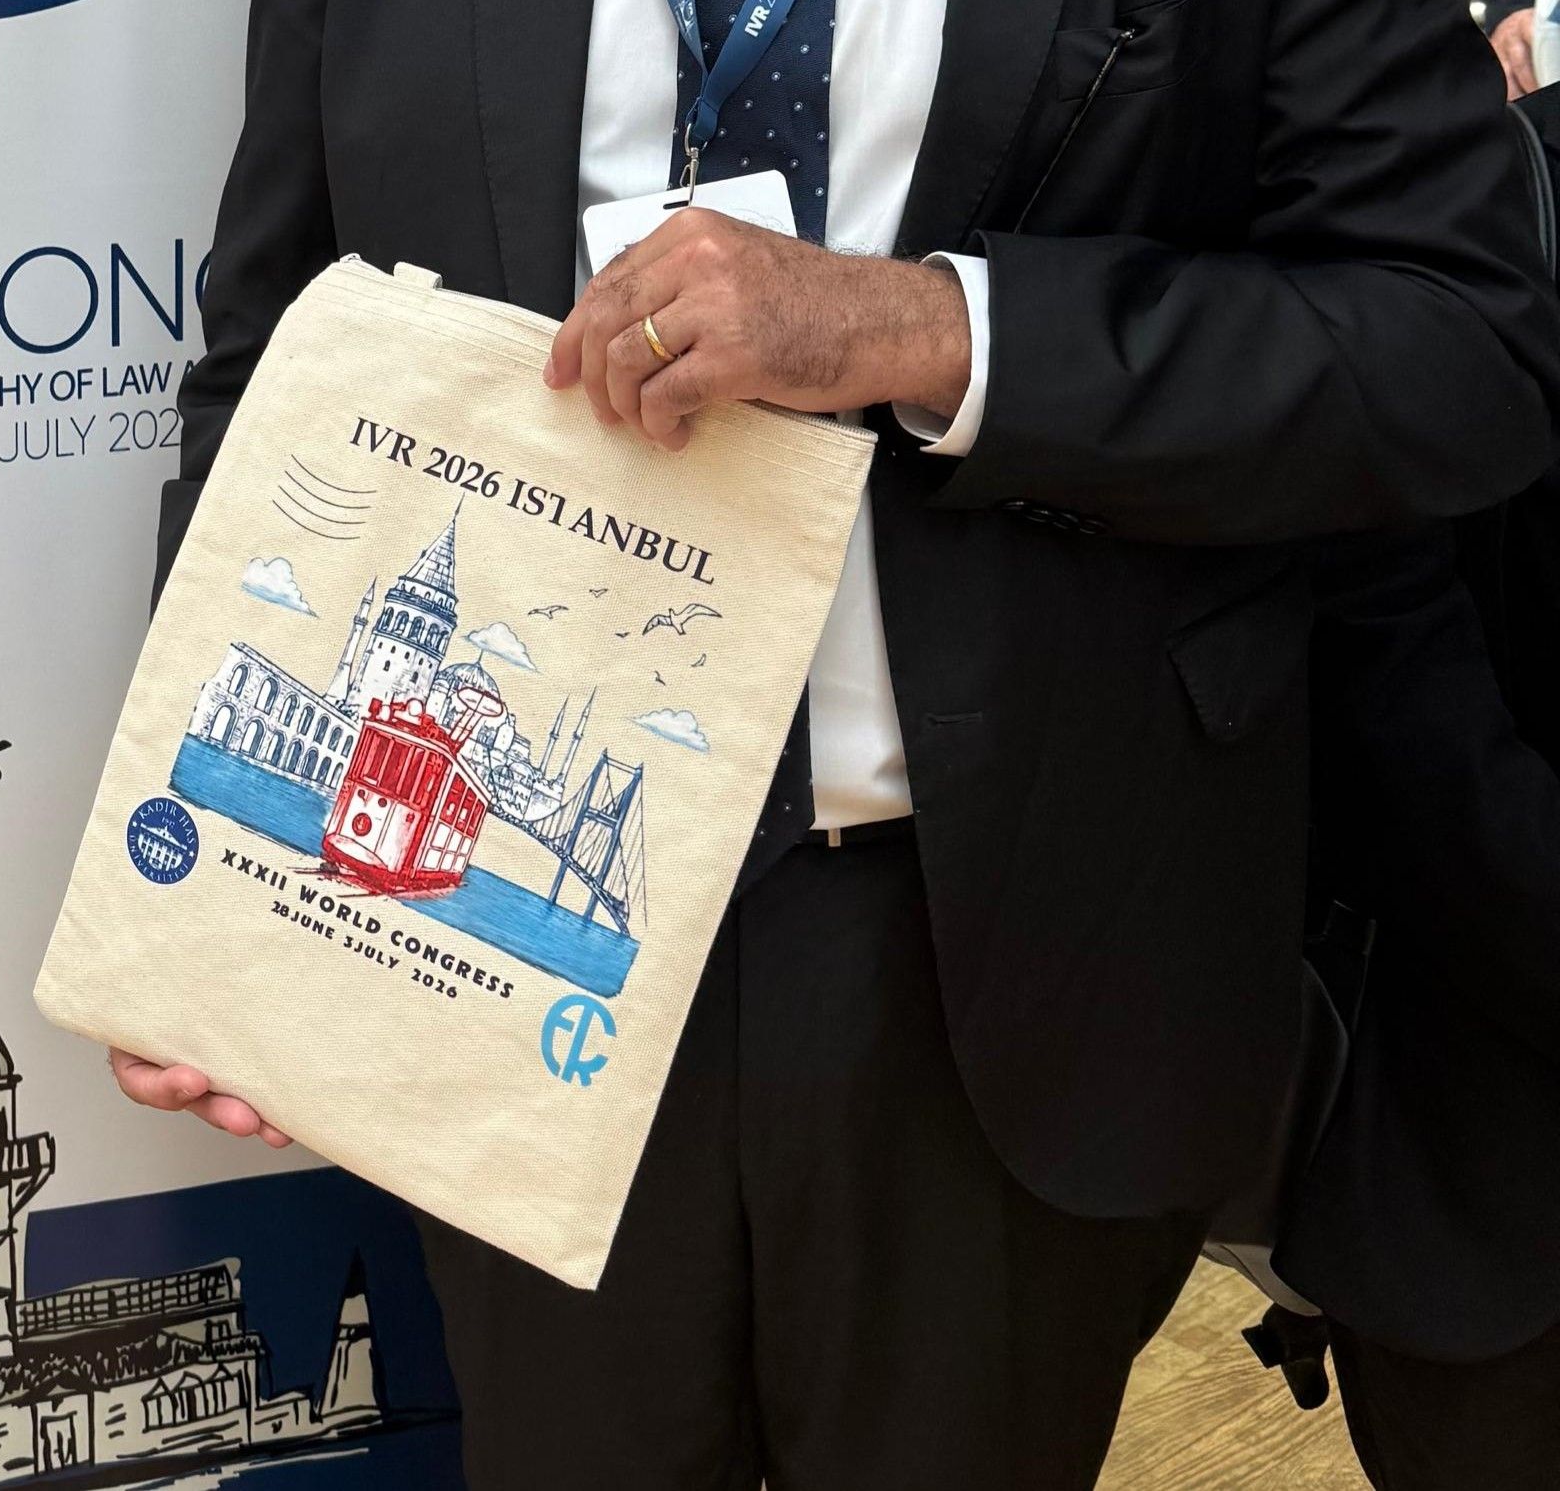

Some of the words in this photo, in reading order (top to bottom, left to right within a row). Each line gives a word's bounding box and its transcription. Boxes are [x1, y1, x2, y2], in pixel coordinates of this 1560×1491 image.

[744, 5, 770, 38] IVR
[49, 368, 93, 402] OF
[102, 361, 173, 398] LAW
[109, 408, 181, 452] 202
[349, 416, 417, 468] IVR
[422, 446, 503, 498] 2026
[506, 478, 715, 585] ISTANBUL
[179, 815, 196, 844] HAS
[220, 848, 288, 891] XXXII
[299, 884, 381, 934] WORLD
[390, 930, 514, 999] CONGRESS
[411, 969, 458, 999] 2026
